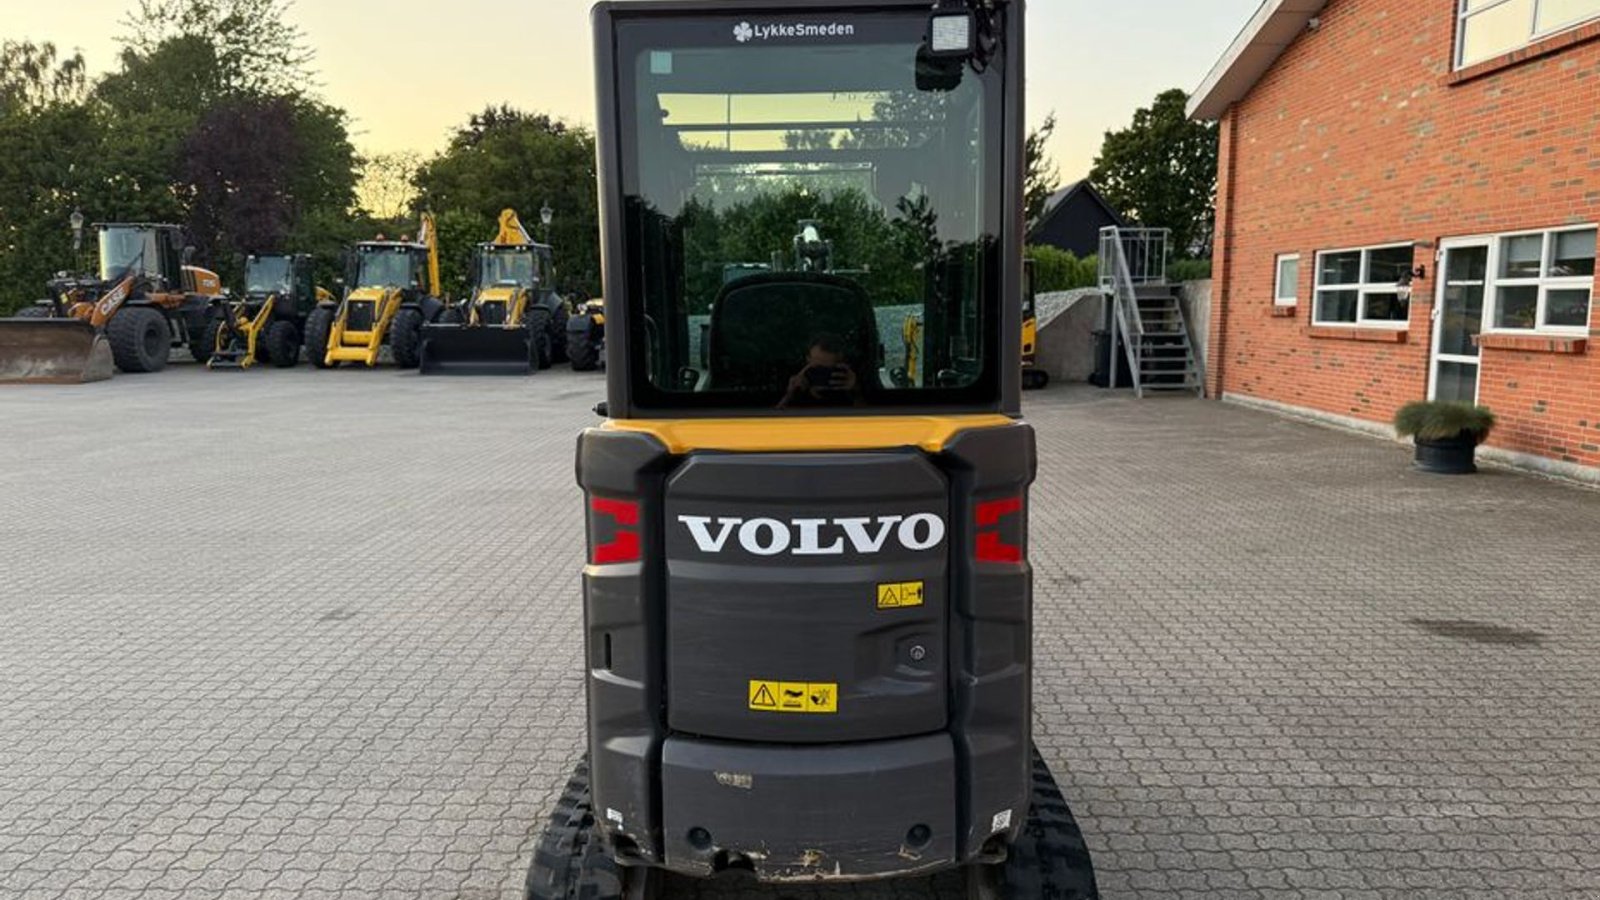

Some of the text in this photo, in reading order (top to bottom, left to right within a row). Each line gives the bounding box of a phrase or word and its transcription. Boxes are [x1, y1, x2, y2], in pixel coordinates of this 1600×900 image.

[754, 23, 854, 40] LykkeSmeden
[101, 286, 126, 315] CASE
[678, 512, 945, 555] VOLVO
